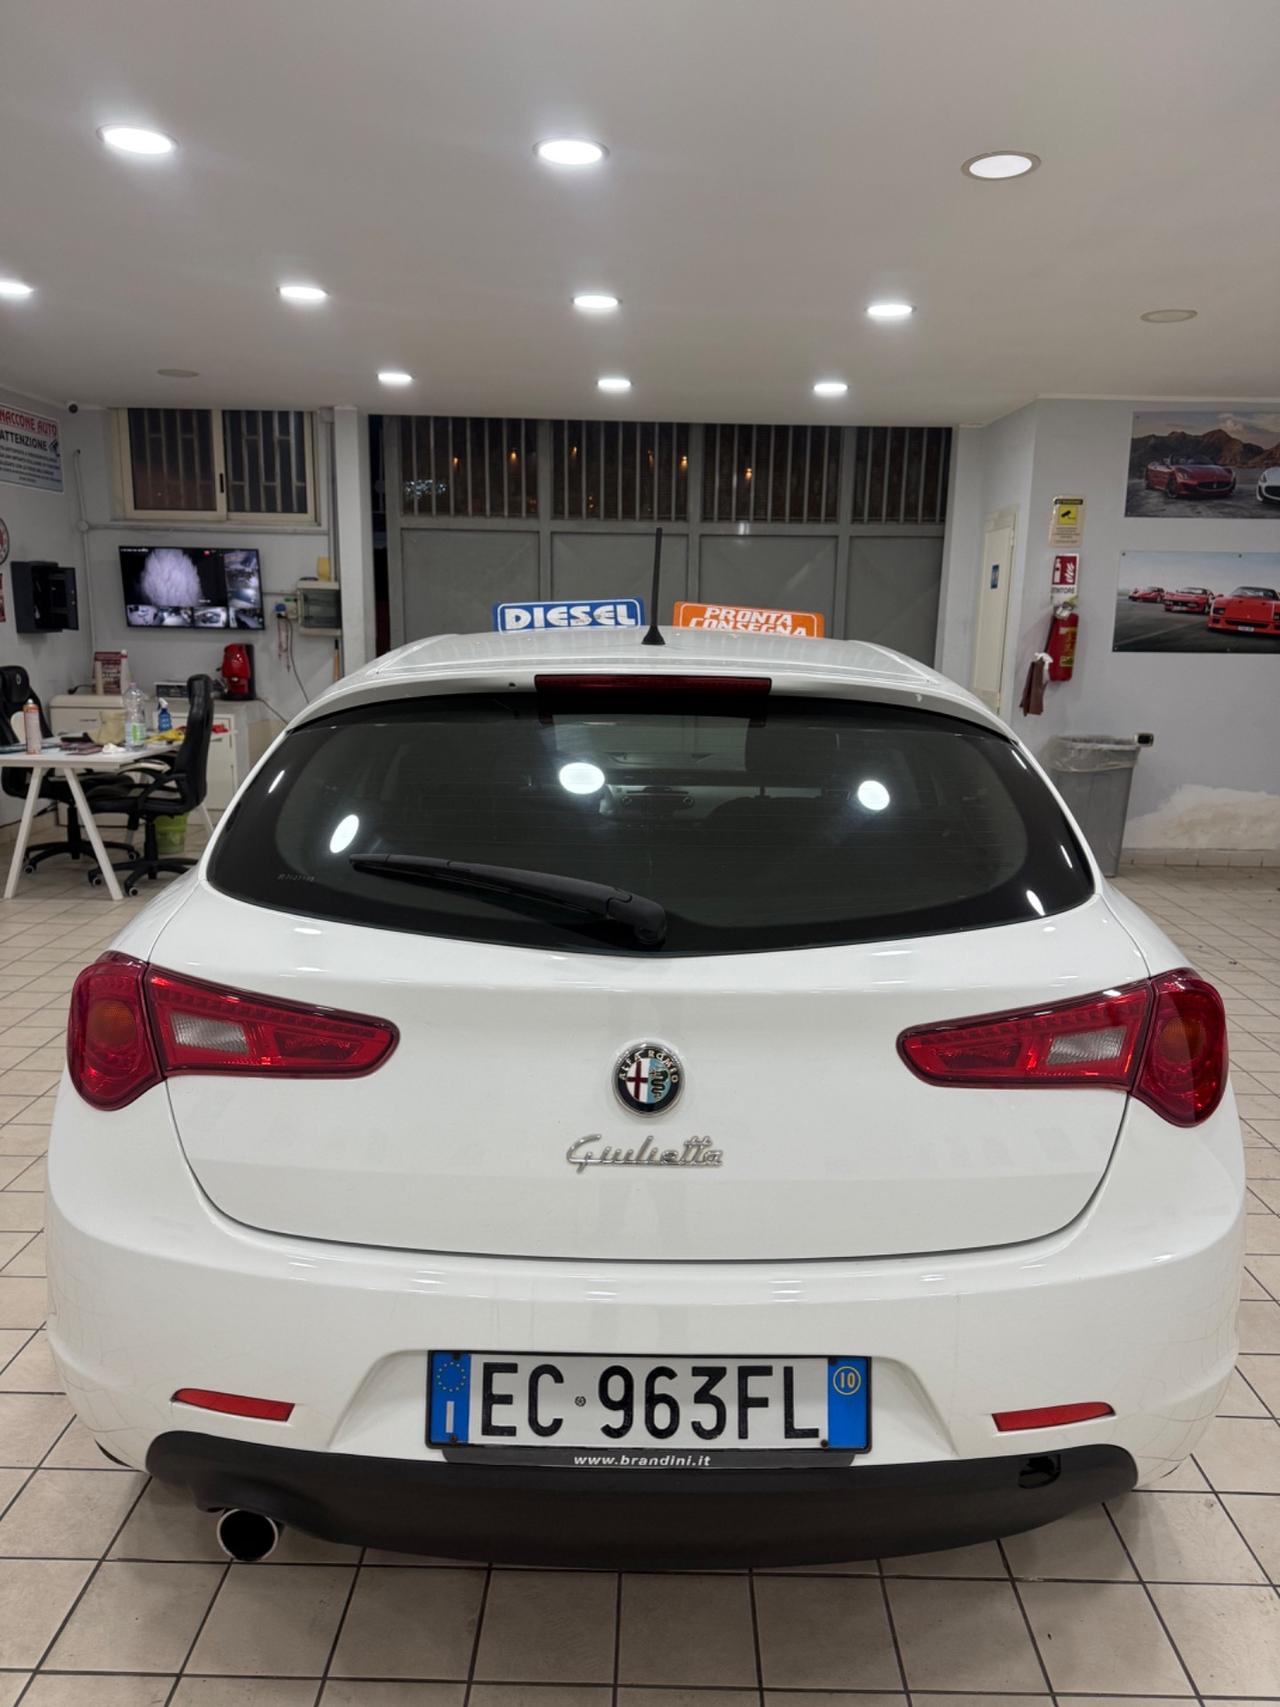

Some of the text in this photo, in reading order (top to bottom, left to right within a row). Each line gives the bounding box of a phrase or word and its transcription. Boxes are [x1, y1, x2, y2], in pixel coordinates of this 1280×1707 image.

[0, 430, 49, 452] ATTENZIONE
[505, 604, 636, 630] DIESEL
[688, 617, 807, 637] CONSEGNA
[704, 607, 792, 626] PRONTA
[566, 1134, 724, 1174] Giulietta
[839, 1371, 857, 1389] 10
[481, 1362, 820, 1440] EC 963FL
[574, 1455, 712, 1467] www.brandini.it
